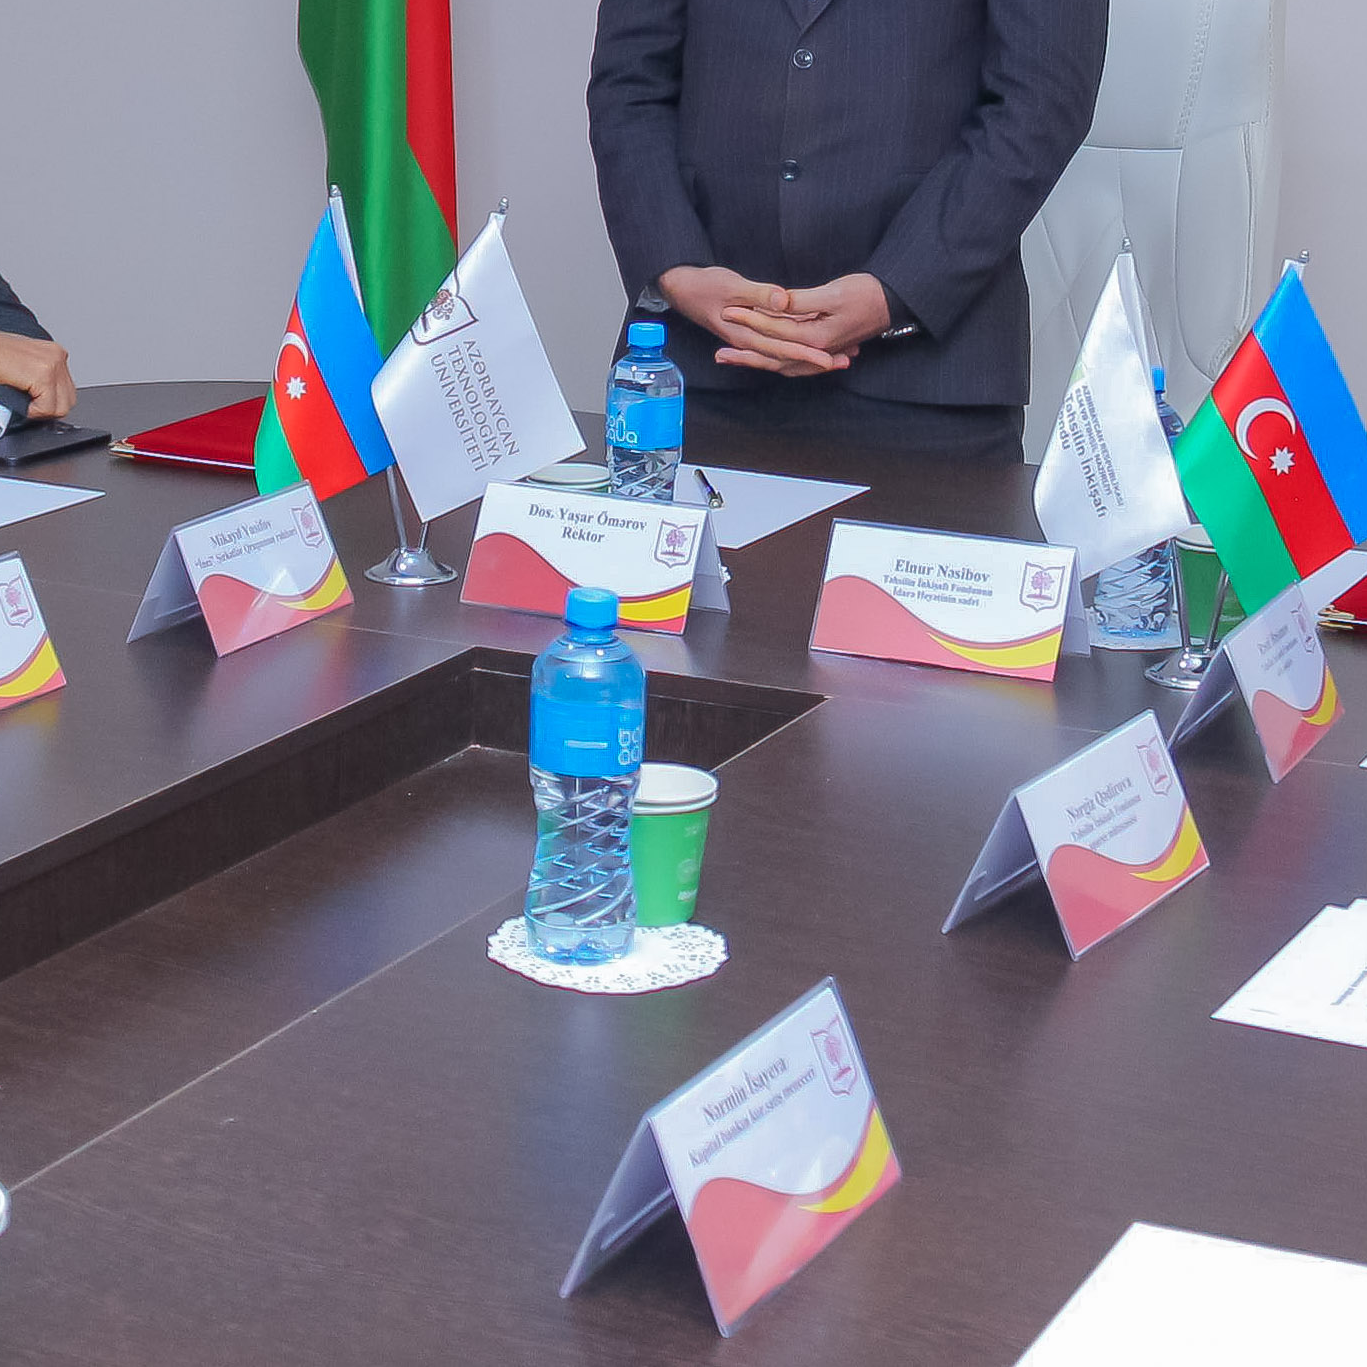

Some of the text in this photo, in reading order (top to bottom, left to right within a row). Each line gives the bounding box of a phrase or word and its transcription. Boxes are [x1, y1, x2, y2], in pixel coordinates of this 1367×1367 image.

[463, 340, 520, 455] AZƏRBAYCAN
[1064, 392, 1108, 518] Təhsilin İnkişafı
[559, 507, 594, 524] Yaşar
[597, 510, 647, 531] Ömərov
[561, 526, 605, 543] Rektor
[894, 559, 990, 582] Elnur Nəsibov
